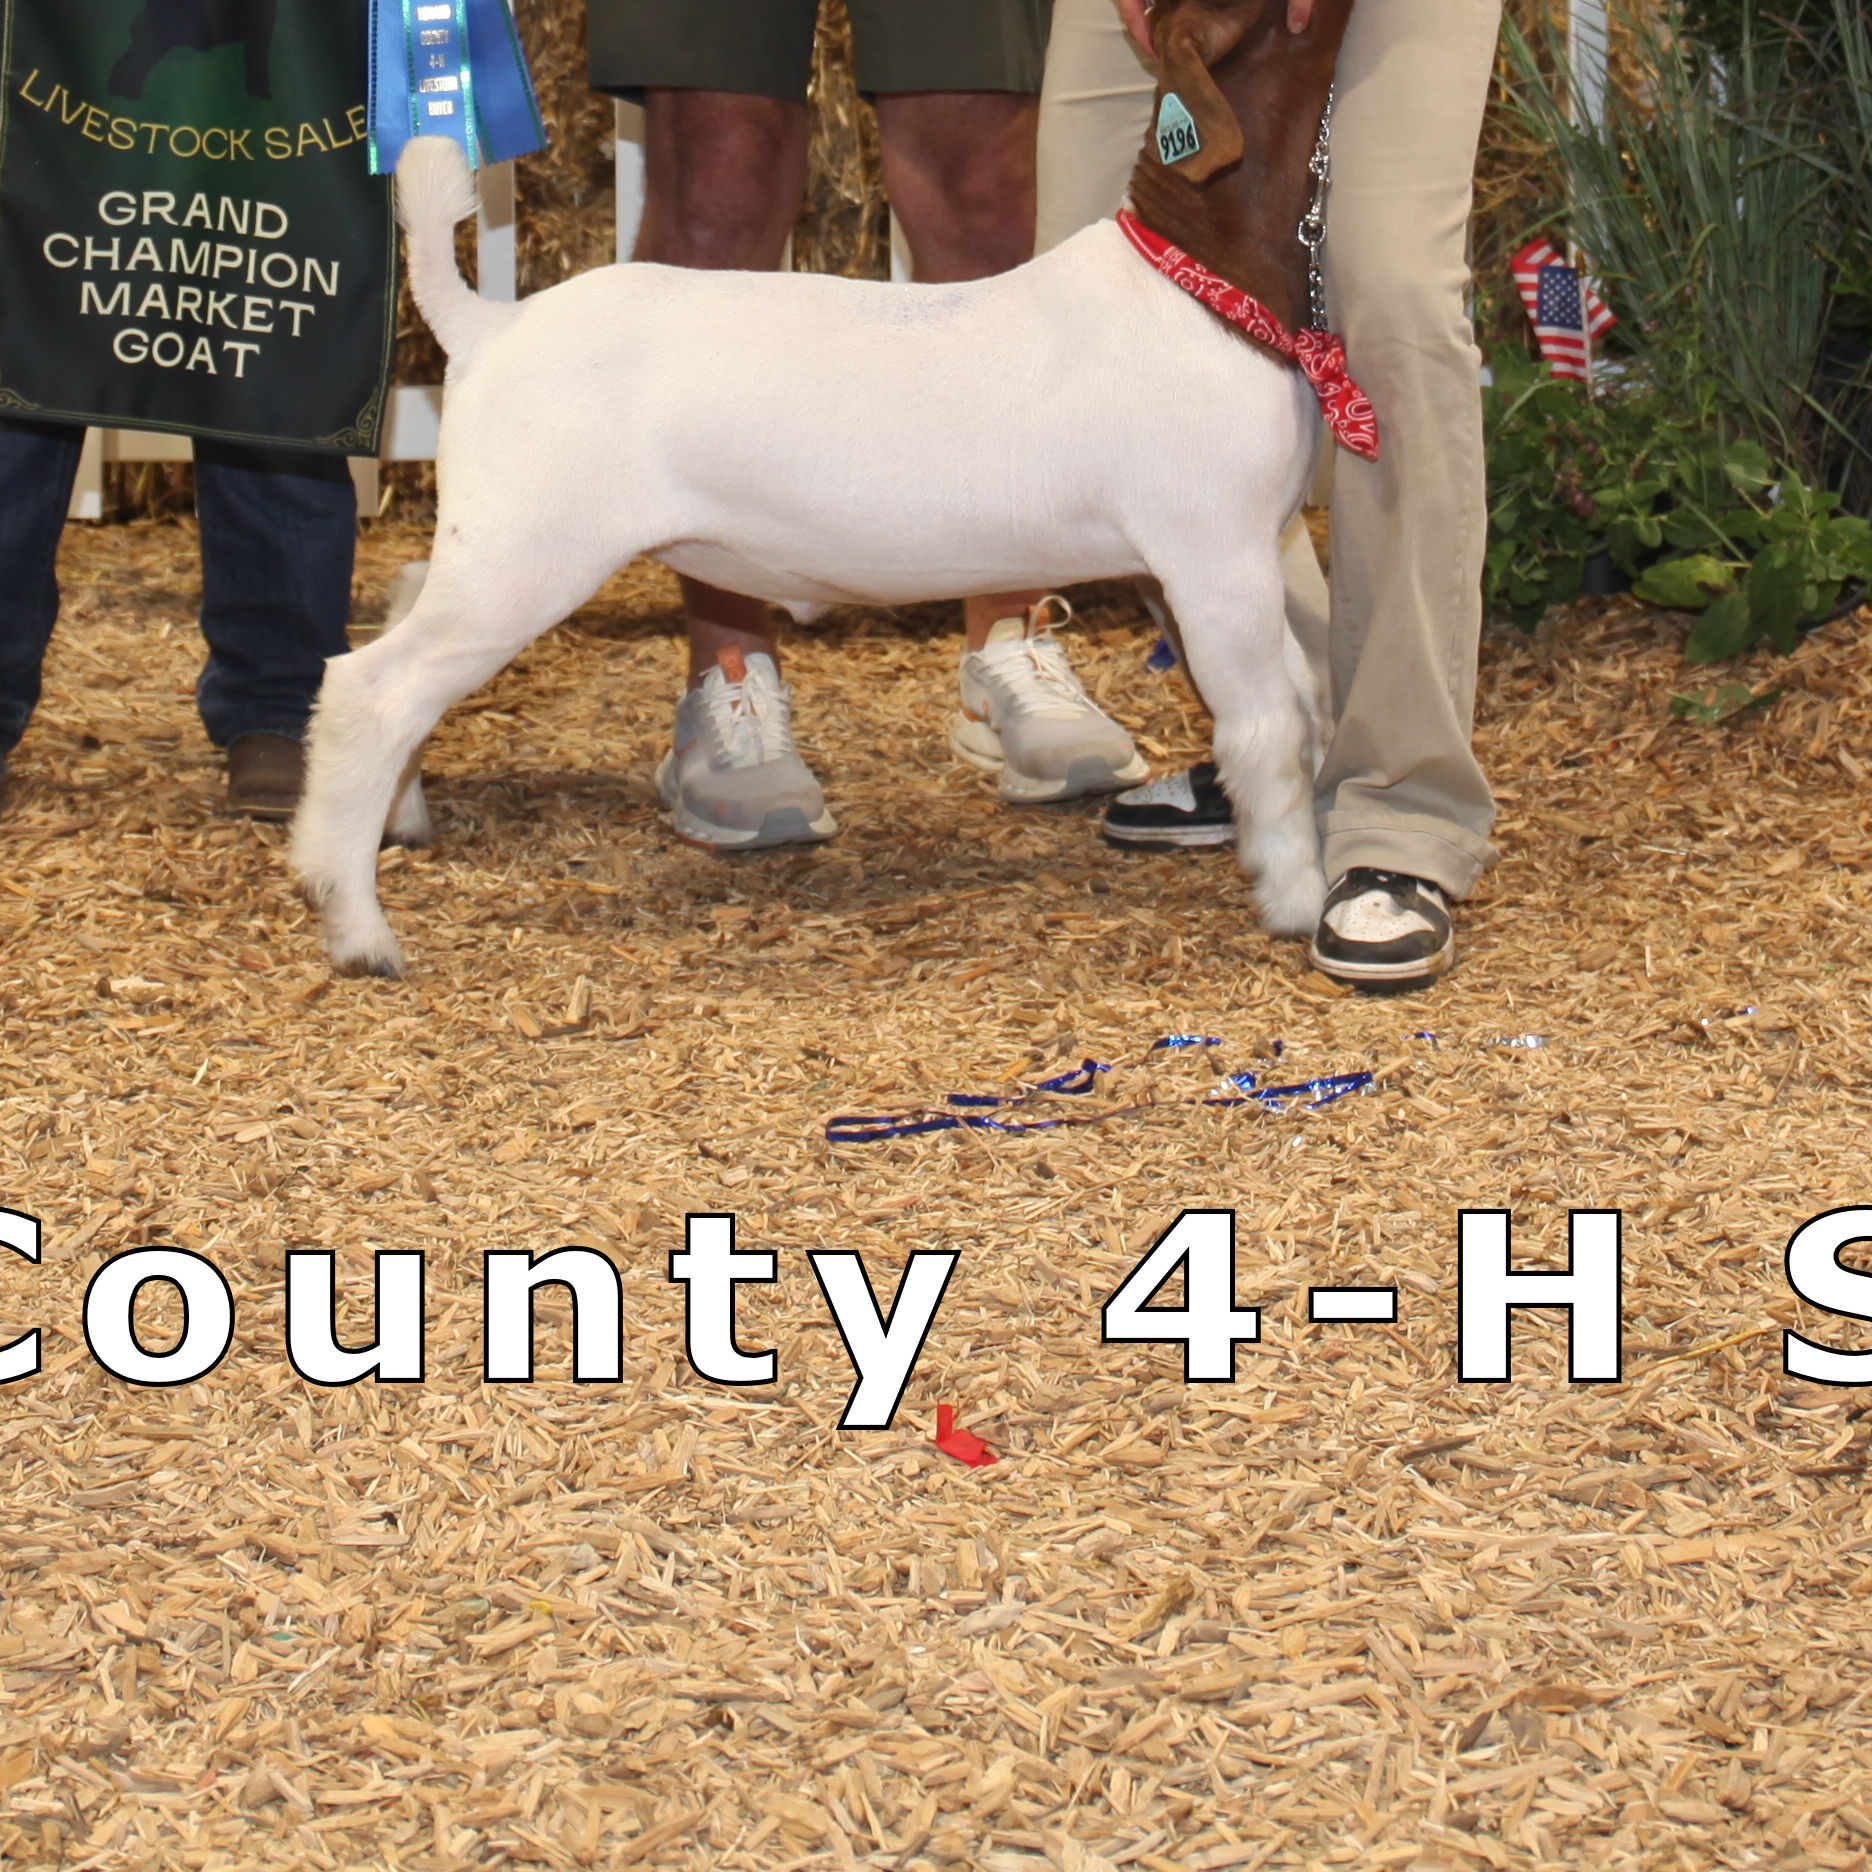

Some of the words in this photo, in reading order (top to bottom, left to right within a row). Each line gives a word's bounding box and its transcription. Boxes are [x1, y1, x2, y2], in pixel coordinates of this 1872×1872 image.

[19, 68, 256, 162] LIVESTOCK
[264, 104, 369, 161] SALE
[1160, 123, 1196, 160] 9196
[98, 191, 288, 240] GRAND
[43, 232, 340, 297] CHAMPION
[80, 281, 315, 337] MARKET
[112, 327, 261, 378] GOAT
